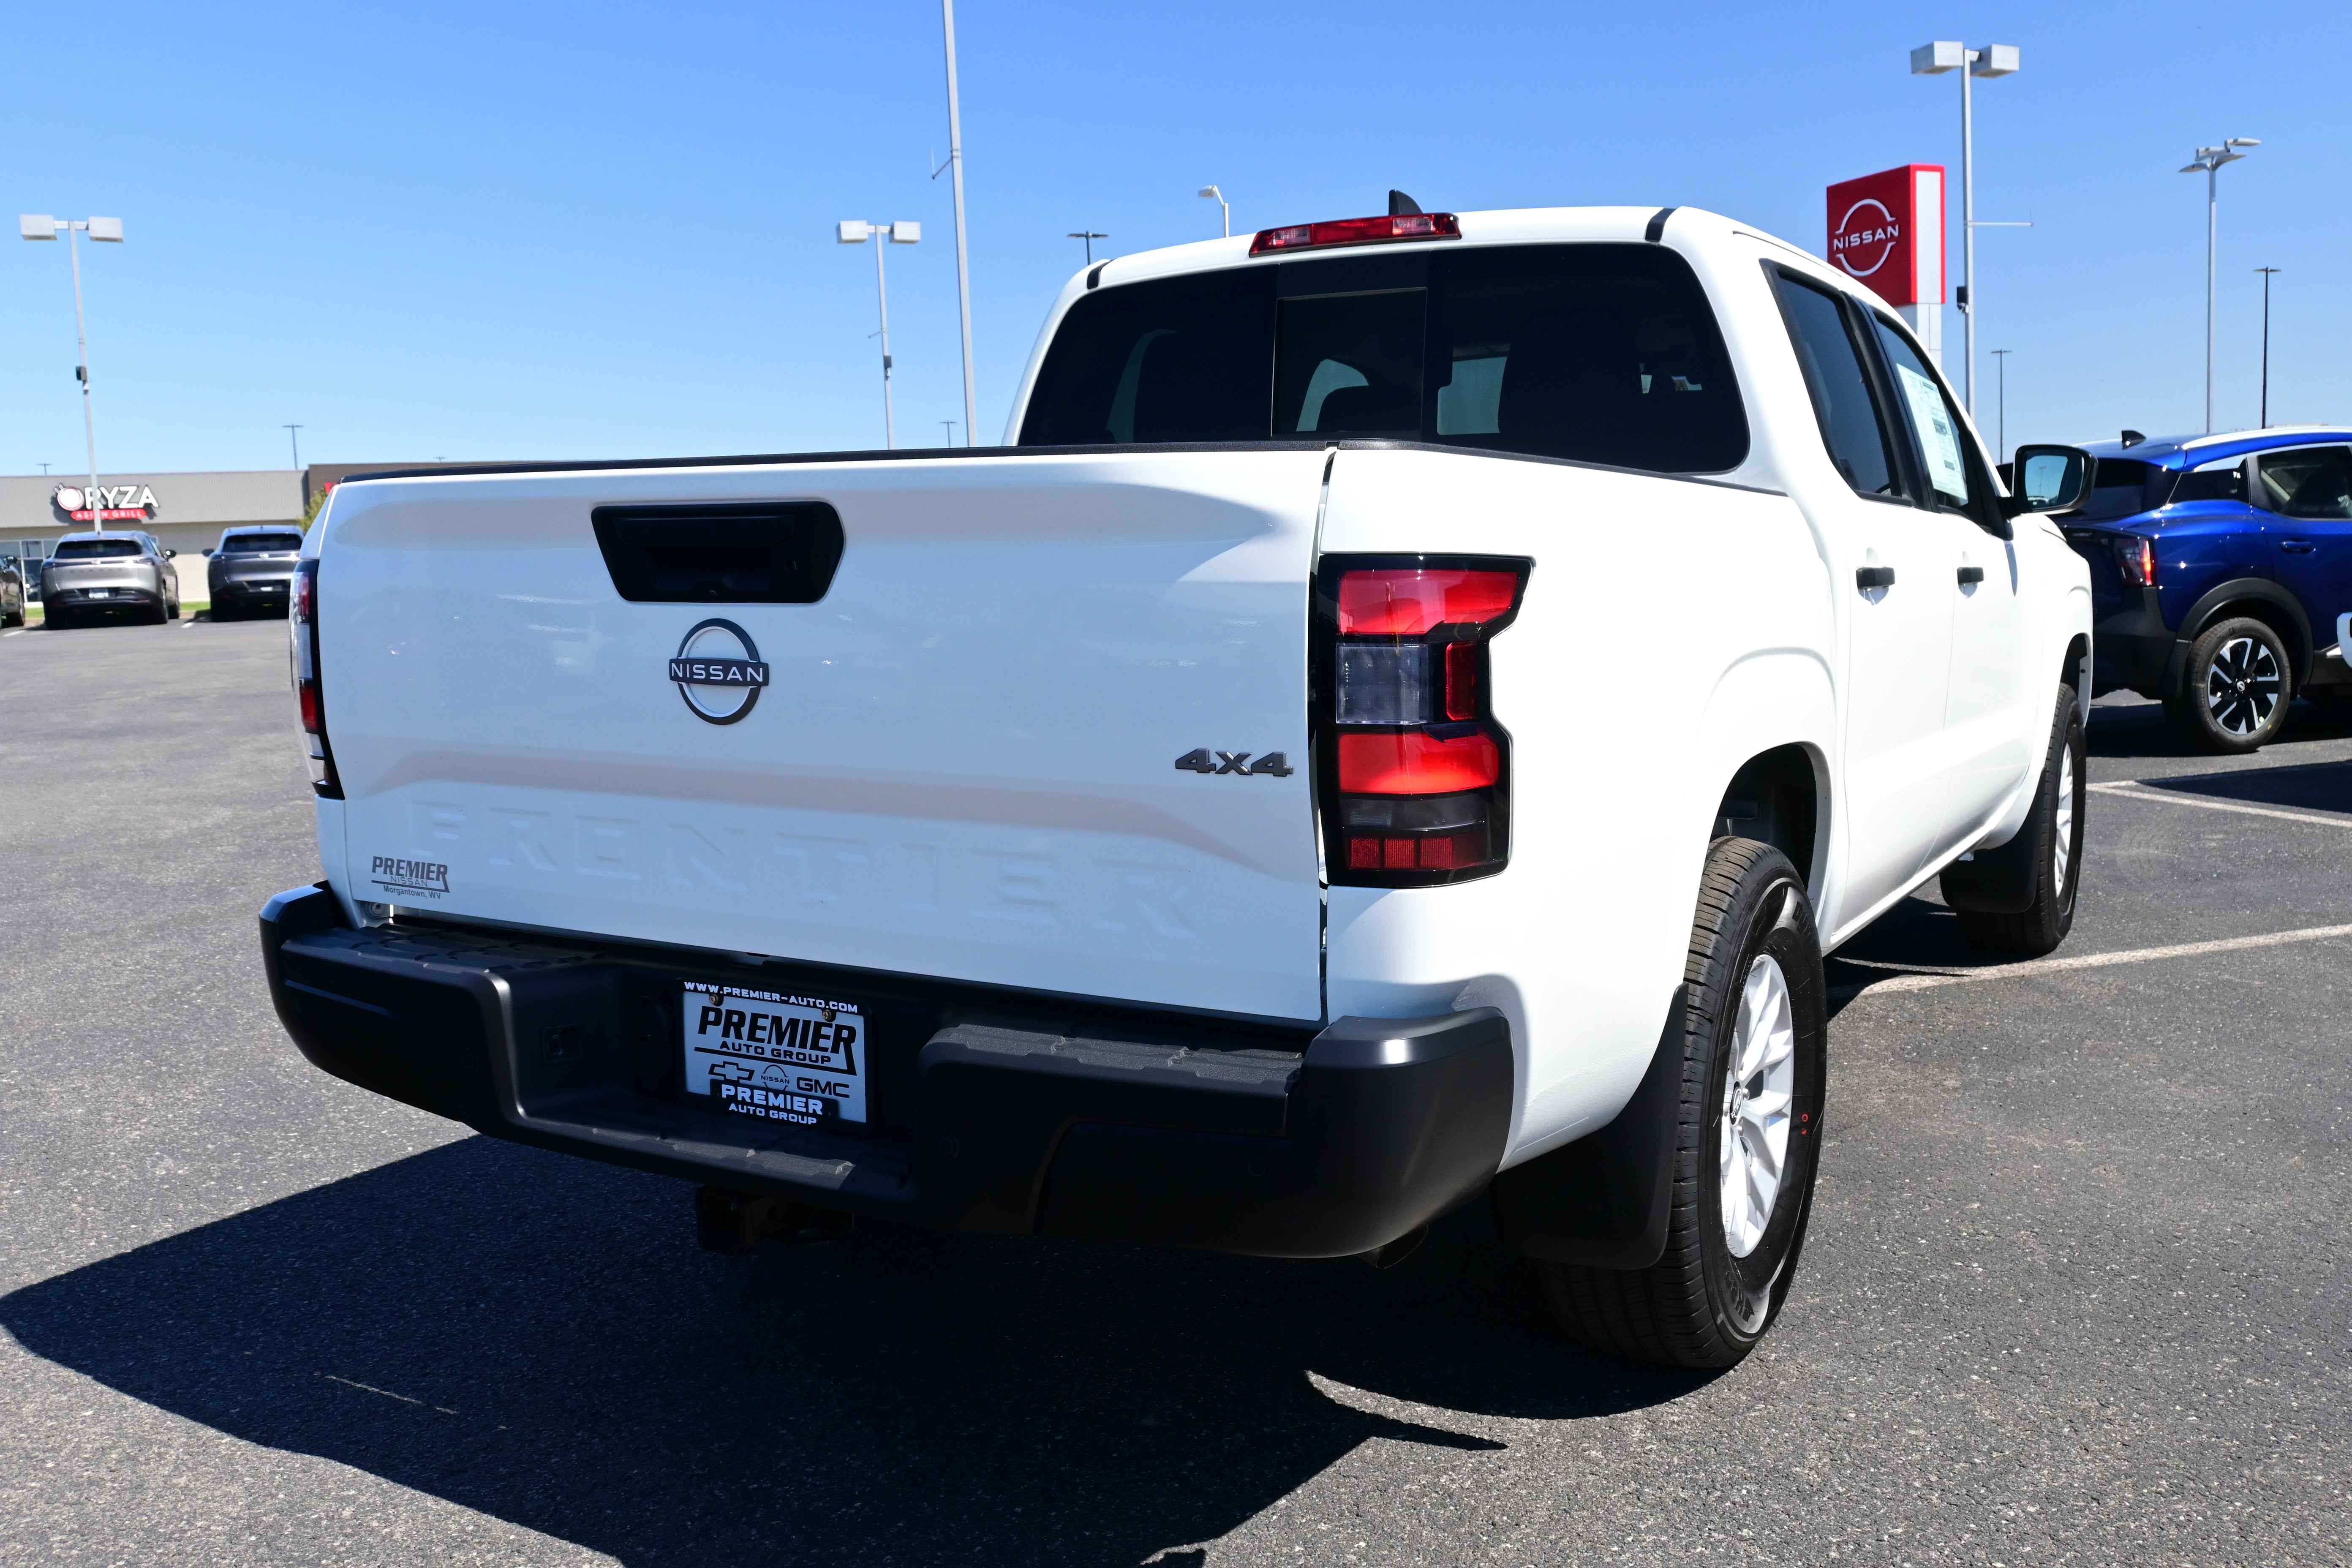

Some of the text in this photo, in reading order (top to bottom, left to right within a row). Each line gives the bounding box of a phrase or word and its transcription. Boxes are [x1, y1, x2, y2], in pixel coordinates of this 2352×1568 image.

[1833, 224, 1899, 251] NISSAN
[112, 509, 142, 518] GRILL
[672, 663, 763, 682] NISSAN
[372, 856, 450, 893] PREMIER
[391, 876, 428, 887] NISSAN
[384, 885, 441, 899] Morgantown, WV
[684, 981, 858, 1013] WWW.PREMIER-AUTO.COM
[697, 1006, 857, 1076] PREMIER
[719, 1040, 831, 1064] AUTO GROUP
[761, 1075, 790, 1084] NISSAN
[797, 1076, 850, 1098] GMC
[722, 1084, 823, 1115] PREMIER
[729, 1103, 817, 1124] AUTO GROUP
